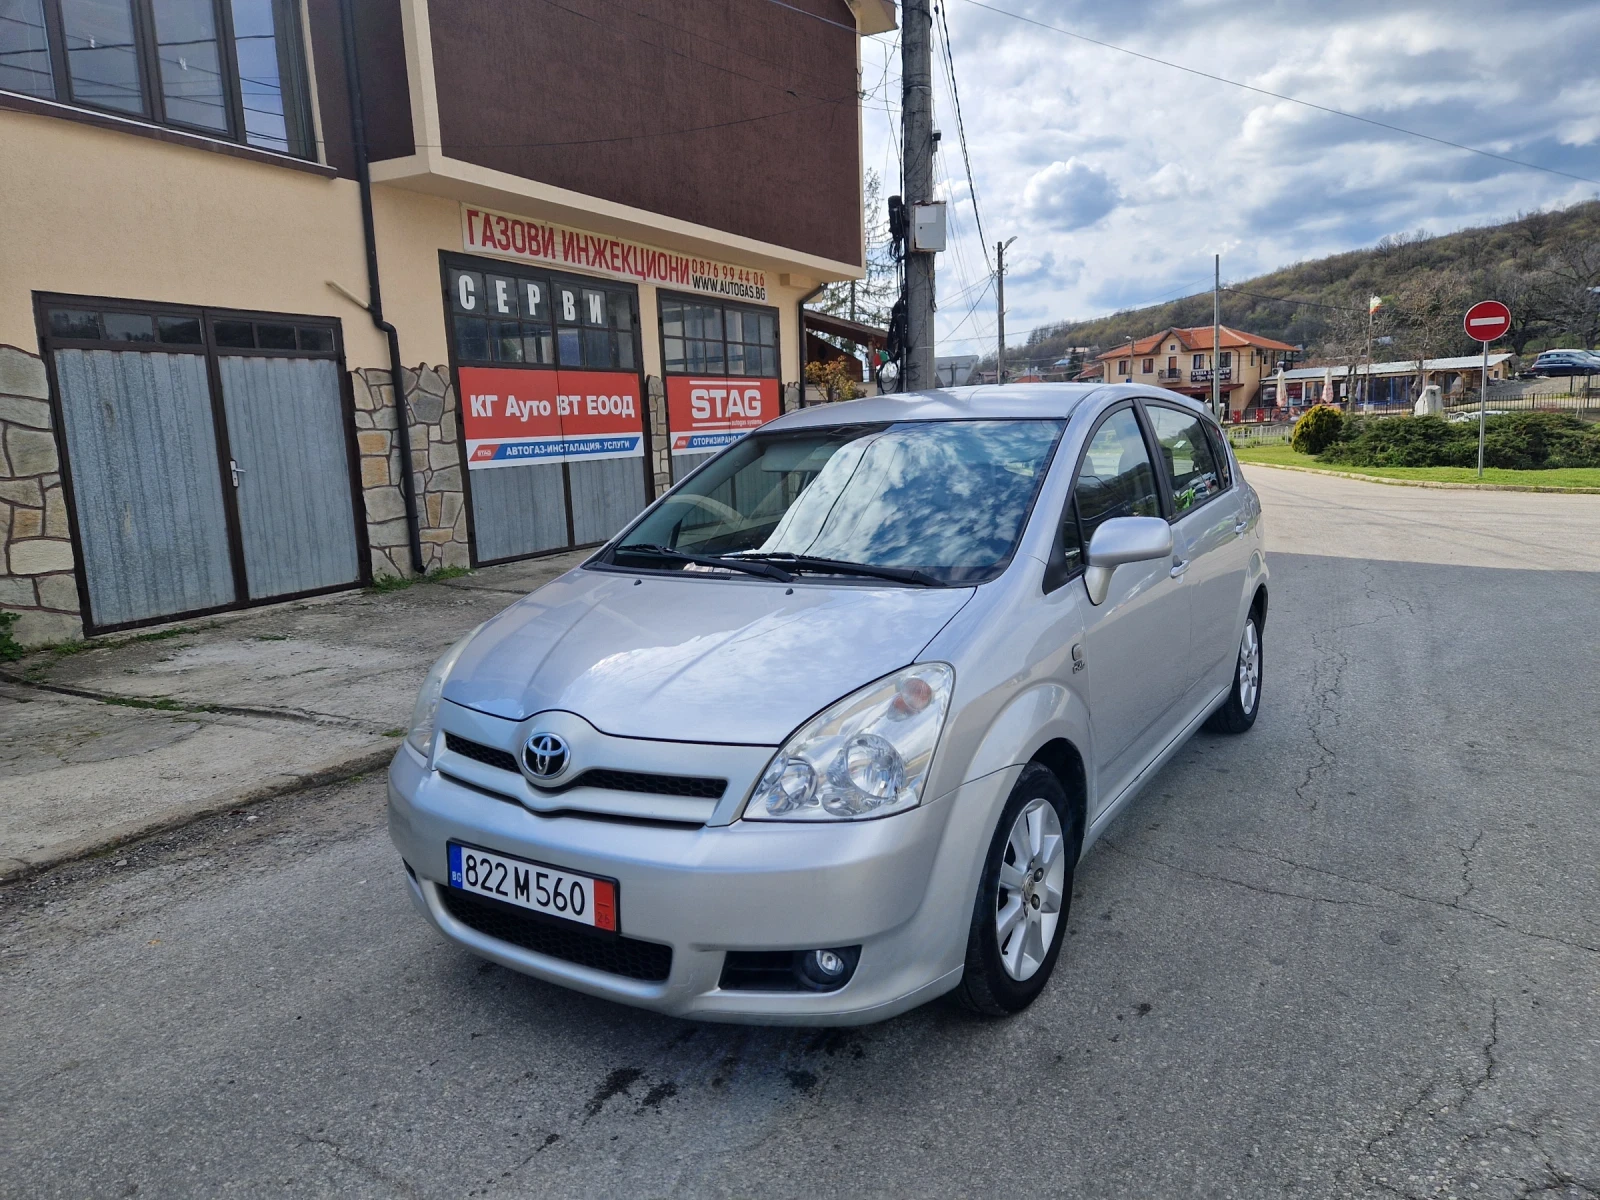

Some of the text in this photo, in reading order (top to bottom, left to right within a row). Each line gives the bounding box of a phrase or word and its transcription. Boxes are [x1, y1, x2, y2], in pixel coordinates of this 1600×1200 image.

[467, 209, 690, 285] ГАЗОВИ ИНЖЕКЦИОНИ
[692, 259, 765, 287] 0876 99 44 06
[692, 274, 766, 301] WWW.AUTOGAS.BG
[470, 395, 635, 422] КГ Ауто ВТ ЕООД
[691, 389, 761, 419] STAG
[603, 440, 630, 450] УСЛУГИ
[452, 871, 462, 882] BG
